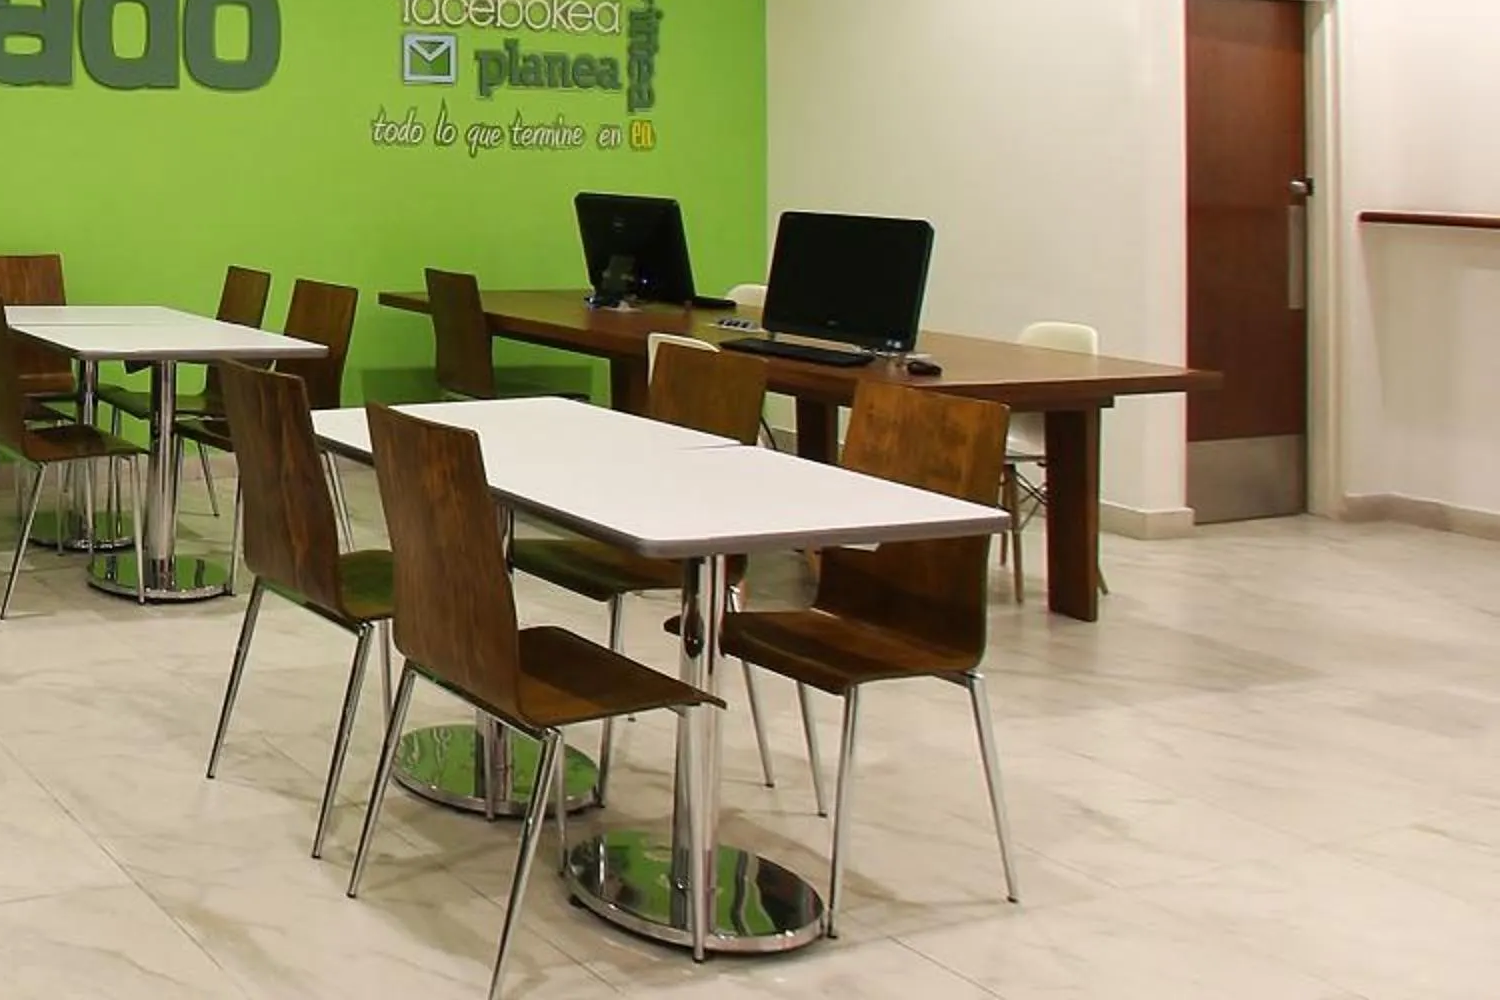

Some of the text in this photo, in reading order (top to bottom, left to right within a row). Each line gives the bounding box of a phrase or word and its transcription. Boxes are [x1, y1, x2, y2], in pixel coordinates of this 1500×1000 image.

[474, 38, 622, 98] planea
[372, 106, 424, 146] todo
[434, 98, 457, 146] lo
[467, 124, 502, 157] que
[510, 109, 583, 147] termine
[598, 125, 621, 147] en
